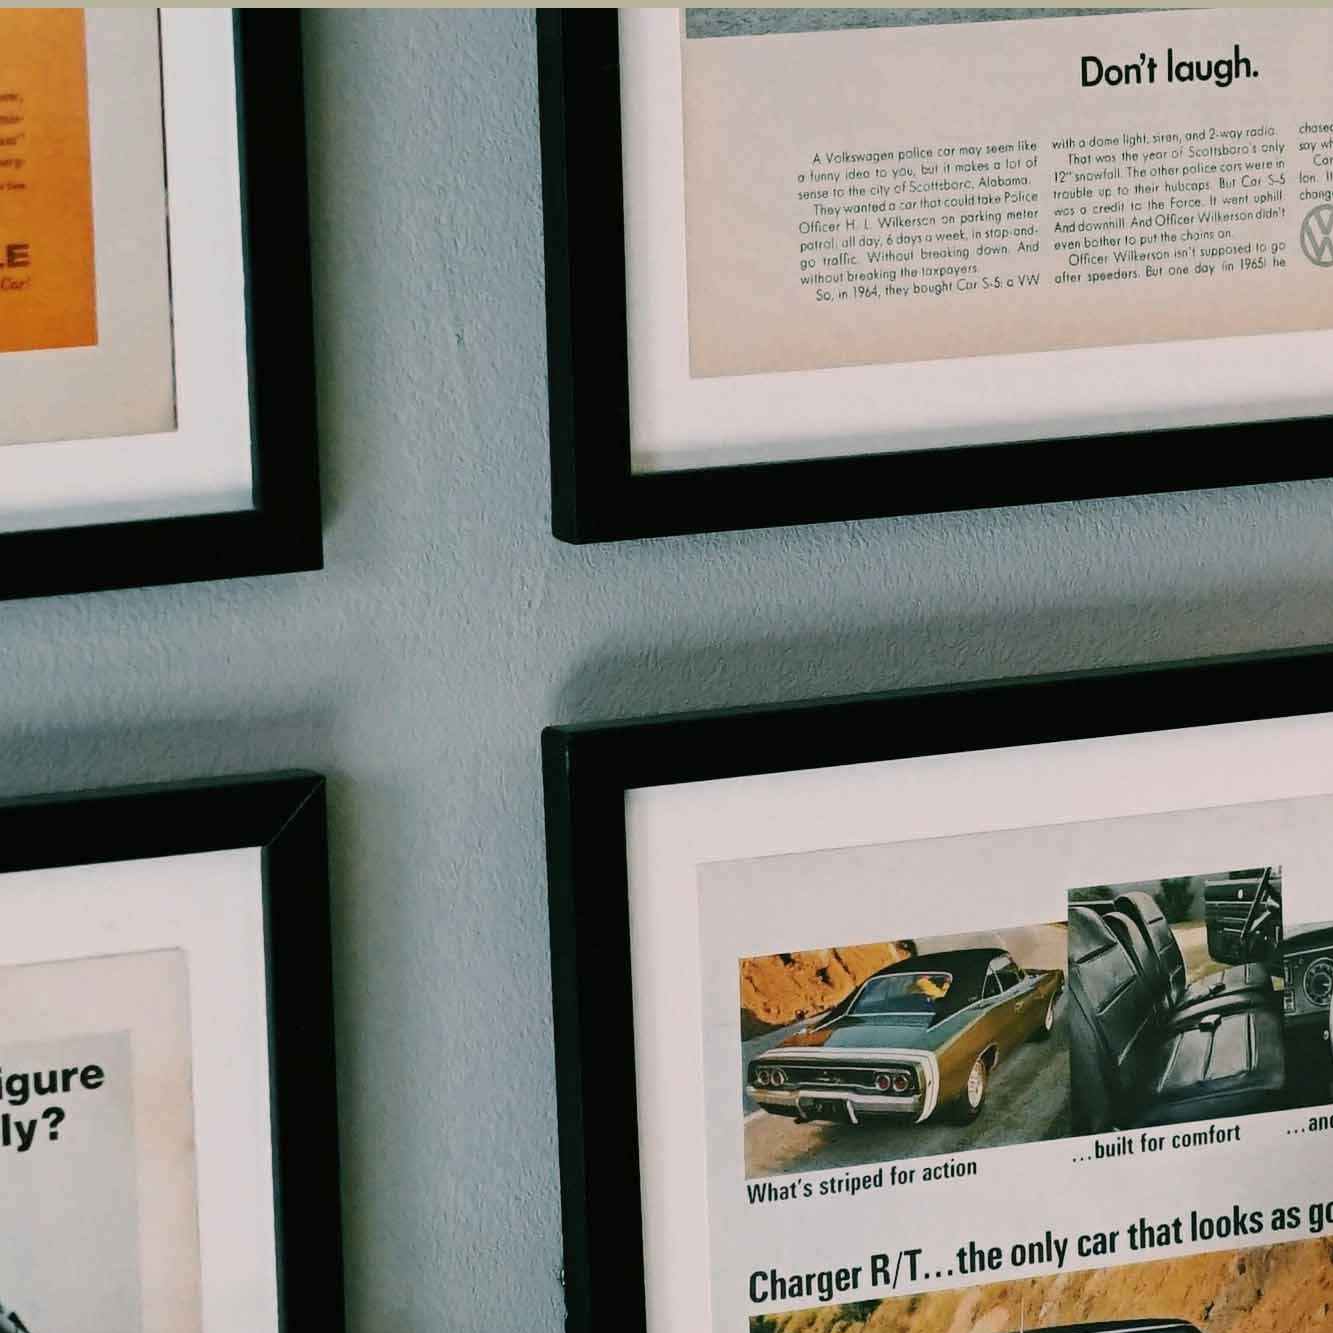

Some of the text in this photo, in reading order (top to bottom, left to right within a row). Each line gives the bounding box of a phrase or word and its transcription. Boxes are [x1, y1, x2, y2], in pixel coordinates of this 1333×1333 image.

[1081, 43, 1259, 88] Don't laugh.
[812, 152, 821, 165] A
[1139, 1132, 1167, 1154] for
[1171, 1123, 1241, 1150] comfort
[746, 1158, 977, 1204] What's striped for action
[749, 1266, 862, 1303] Charger
[1009, 1230, 1069, 1270] only
[1076, 1229, 1120, 1258] car
[1125, 1215, 1184, 1252] that
[1191, 1204, 1263, 1241] looks
[1270, 1205, 1301, 1232] as
